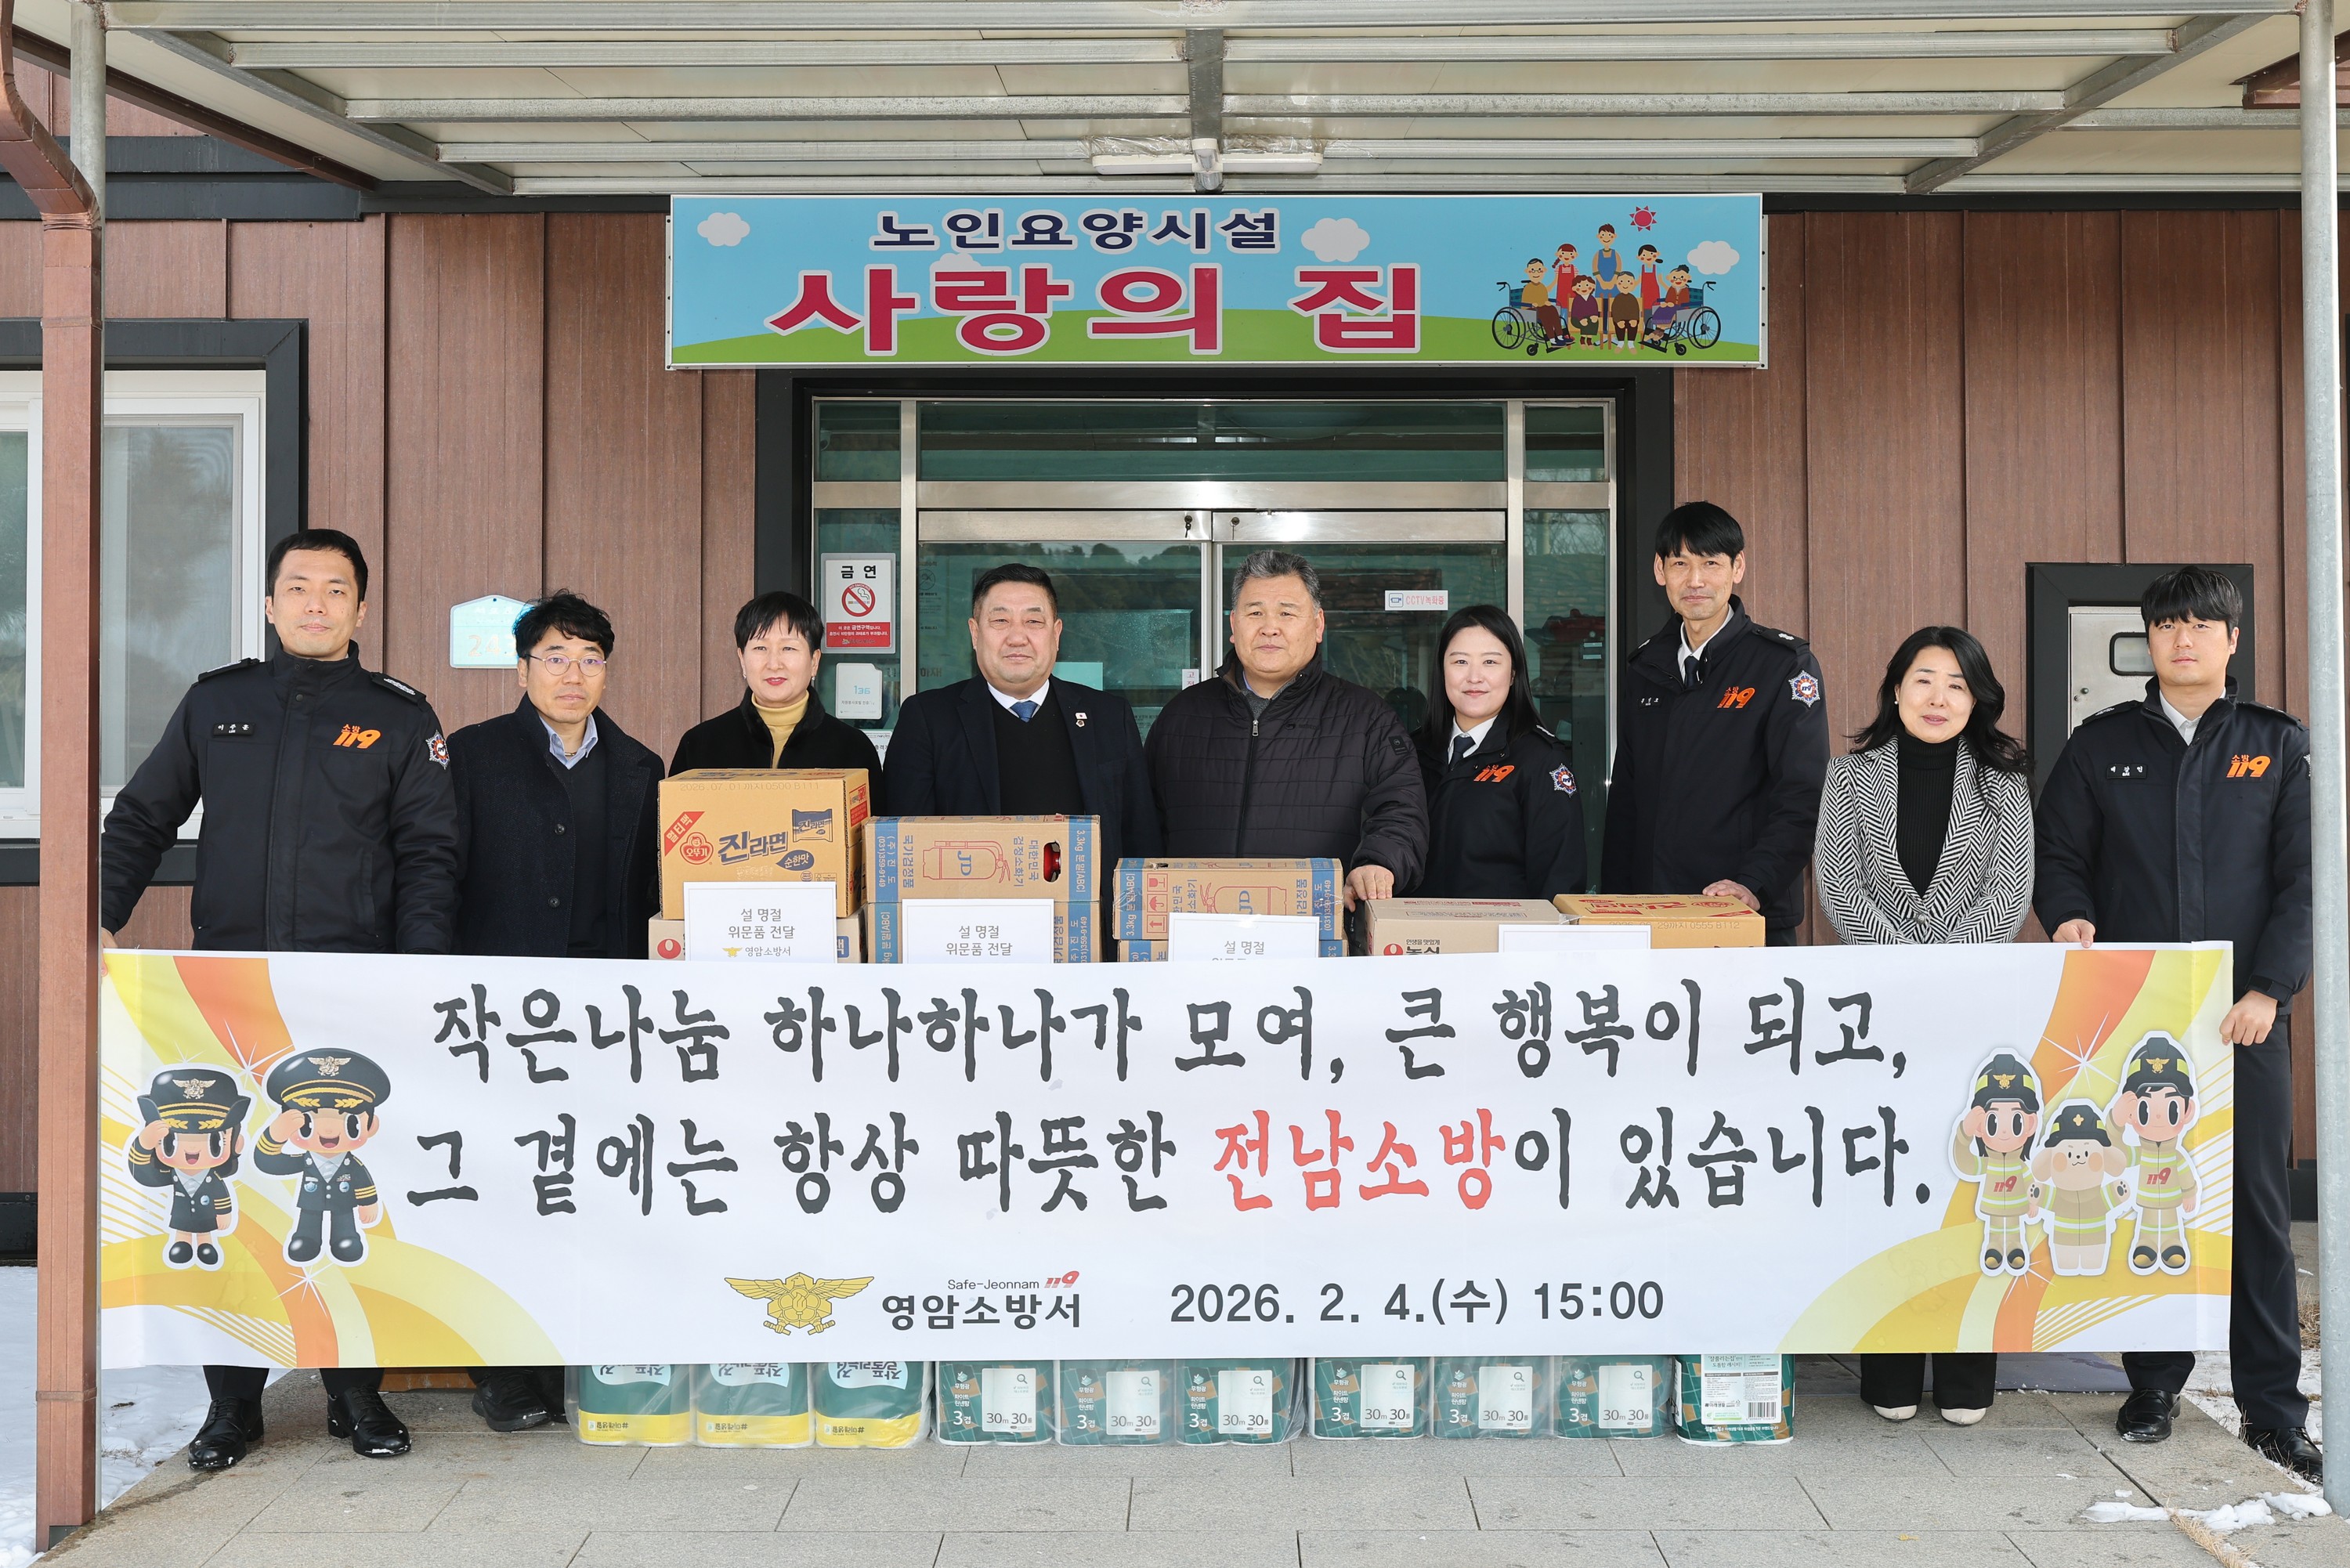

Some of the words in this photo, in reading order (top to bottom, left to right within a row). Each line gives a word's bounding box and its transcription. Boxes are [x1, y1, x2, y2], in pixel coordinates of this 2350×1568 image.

[874, 212, 1276, 250] 노인요양시설
[772, 268, 1217, 351] 사랑의
[1296, 268, 1415, 349] 집
[1405, 595, 1444, 605] CCTV녹화중
[1717, 687, 1755, 709] 119
[342, 724, 361, 733] 소방
[333, 729, 381, 749] 119
[2226, 754, 2271, 778] 119
[2231, 754, 2250, 763] 소방
[1473, 765, 1515, 782] 119
[666, 814, 693, 844] 멀티팩
[798, 819, 825, 833] 진라면
[718, 830, 789, 865] 진라면
[1076, 830, 1086, 852] 3.3kg
[686, 847, 708, 858] 오뚜기
[784, 853, 810, 869] 순한맛
[877, 836, 886, 887] (031)359-9149
[902, 835, 914, 888] 국가검정품
[957, 851, 972, 876] JD
[1013, 836, 1024, 887] 검정소화기
[1029, 840, 1039, 881] 대한민국
[1173, 885, 1182, 913] 한민국
[740, 909, 753, 922] 설
[757, 909, 782, 922] 명절
[728, 925, 765, 939] 위문품
[771, 925, 795, 939] 전달
[958, 925, 971, 939] 설
[975, 925, 1000, 939] 명절
[1126, 914, 1137, 936] 3.3kg
[745, 946, 791, 957] 영암소방서
[945, 942, 983, 956] 위문품
[988, 942, 1013, 956] 전달
[1224, 941, 1236, 955] 설
[1241, 941, 1265, 955] 명절
[433, 983, 730, 1084] 작은나눔
[763, 986, 1143, 1083] 하나하나가
[1174, 985, 1344, 1084] 모여,
[1385, 988, 1456, 1080] 큰
[1491, 978, 1701, 1078] 행복이
[1744, 977, 1907, 1079] 되고,
[407, 1130, 479, 1207] 그
[514, 1113, 739, 1216] 곁에는
[773, 1111, 920, 1215] 항상
[957, 1110, 1177, 1212] 따뜻한
[1213, 1107, 1571, 1213] 전남소방이
[1620, 1105, 1930, 1209] 있습니다.
[2146, 1167, 2171, 1185] 119
[1994, 1176, 2017, 1192] 119
[947, 1279, 1039, 1290] Safe-Jeonnam
[1044, 1270, 1080, 1289] 119
[1170, 1283, 1294, 1324] 2026.
[1320, 1283, 1359, 1323] 2.
[1384, 1278, 1507, 1325] 4.(수)
[1535, 1281, 1664, 1320] 15:00
[882, 1294, 1079, 1331] 영암소방서
[953, 1411, 971, 1425] 3겹
[986, 1412, 1009, 1424] 30m
[1077, 1414, 1096, 1429] 3겹
[1111, 1415, 1133, 1427] 30m
[1189, 1413, 1208, 1428] 3겹
[1223, 1414, 1246, 1426] 30m
[1331, 1407, 1350, 1422] 3겹
[1365, 1408, 1387, 1420] 30m
[1449, 1408, 1468, 1423] 3겹
[1483, 1410, 1506, 1422] 30m
[1569, 1407, 1588, 1422] 3겹
[1603, 1409, 1625, 1421] 30m
[596, 1421, 629, 1429] #미래생활
